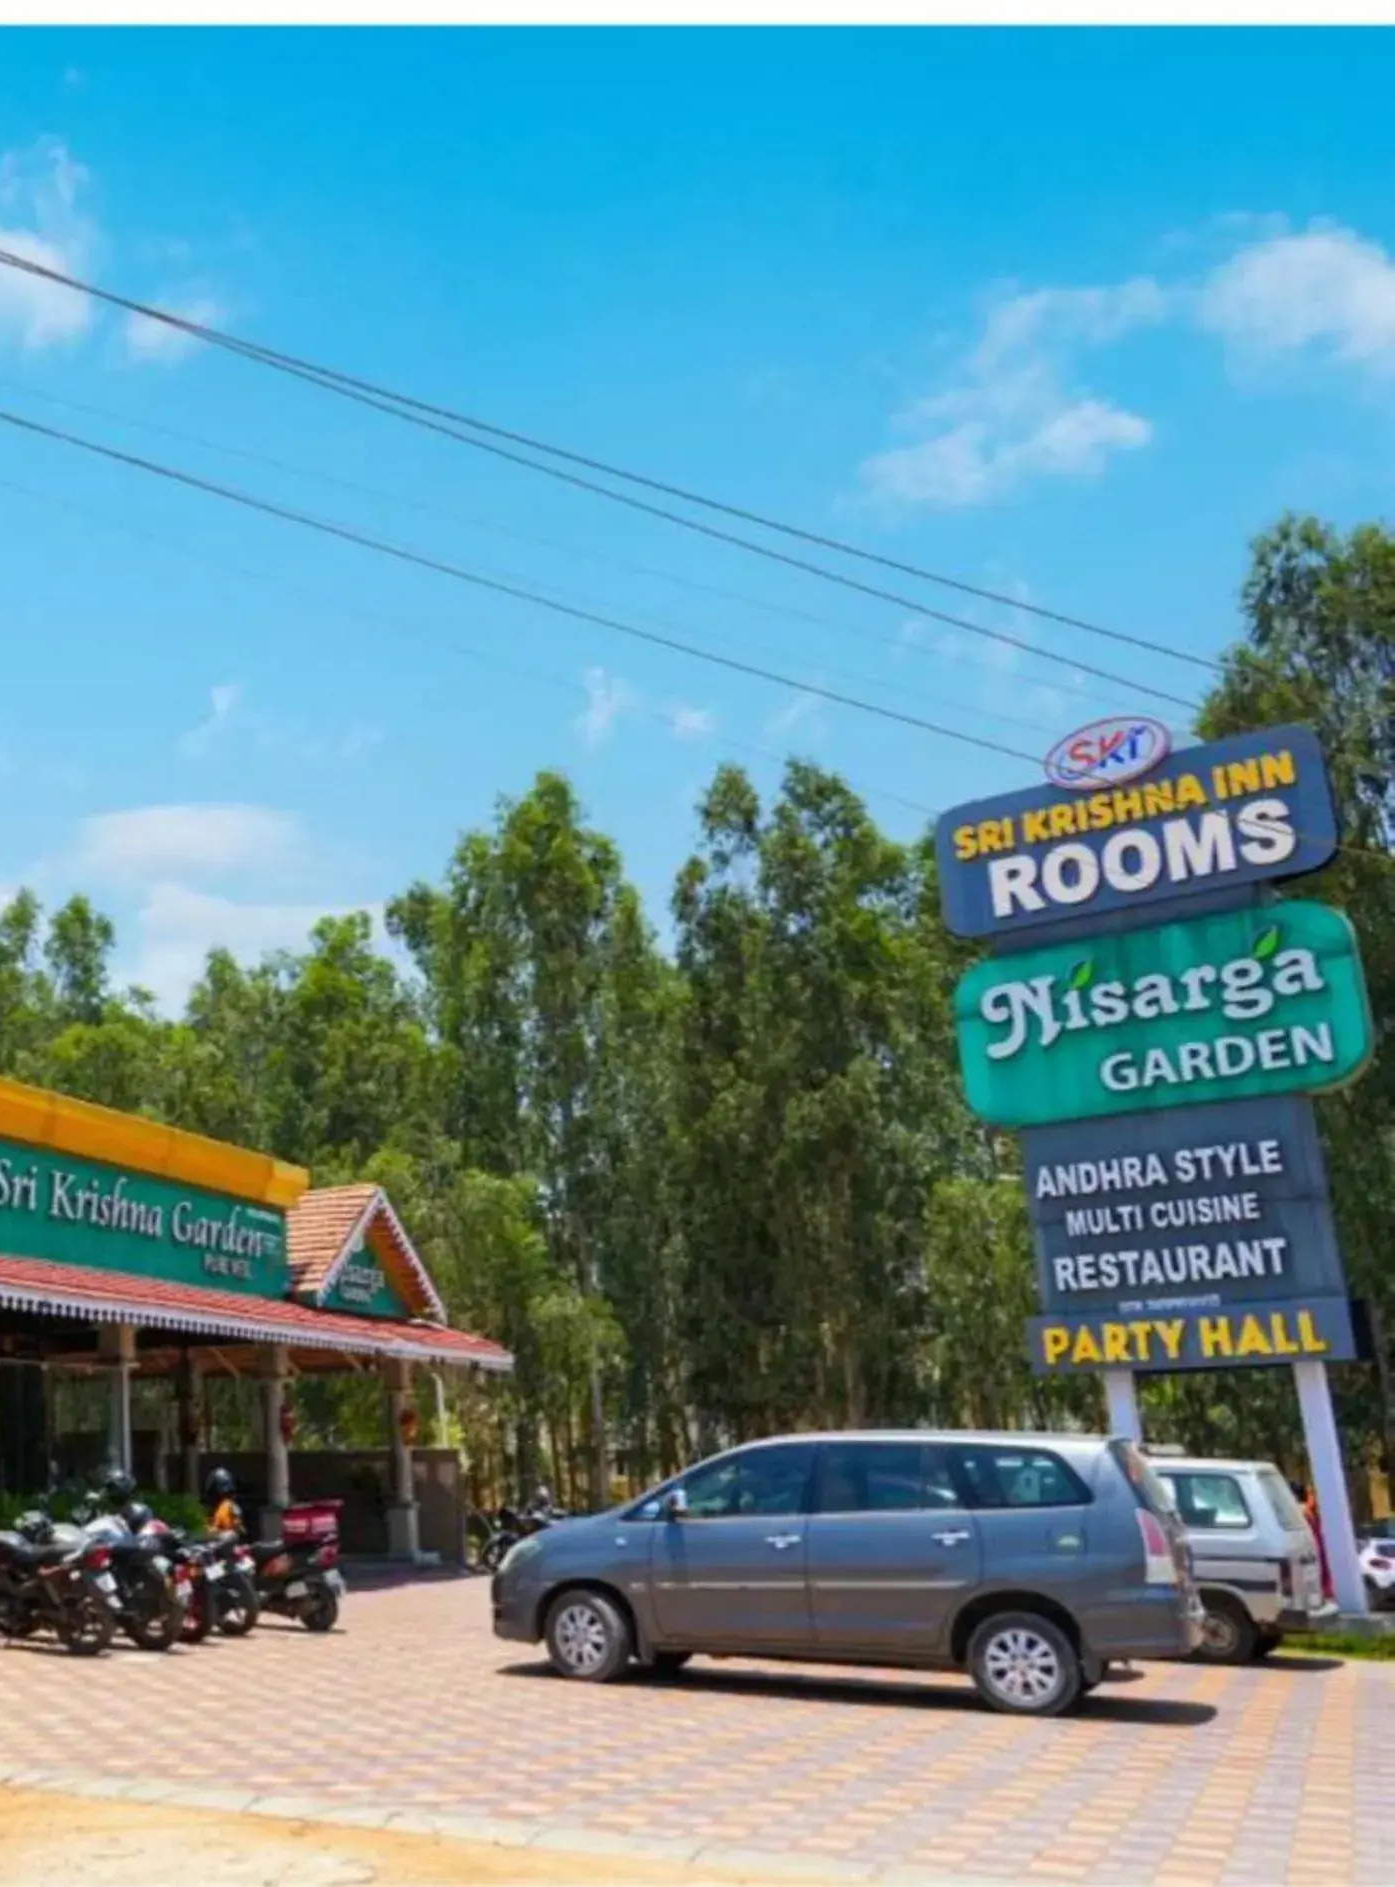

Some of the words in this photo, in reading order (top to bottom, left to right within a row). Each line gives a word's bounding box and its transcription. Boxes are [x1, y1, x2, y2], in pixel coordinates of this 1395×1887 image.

[953, 816, 1015, 860] SRI
[1022, 773, 1208, 847] KRISHNA
[1212, 750, 1297, 799] INN
[987, 798, 1297, 918] ROOMS
[981, 944, 1325, 1060] Nisarga
[1100, 1022, 1334, 1092] GARDEN
[1036, 1153, 1168, 1199] ANDHRA
[1174, 1139, 1283, 1184] STYLE
[50, 1171, 163, 1237] Krishna
[171, 1201, 264, 1259] Garden
[1066, 1203, 1144, 1237] MULTI
[1151, 1193, 1261, 1228] CUISINE
[1054, 1238, 1287, 1292] RESTAURANT
[1041, 1318, 1187, 1366] PARTY
[1199, 1309, 1328, 1358] HALL
